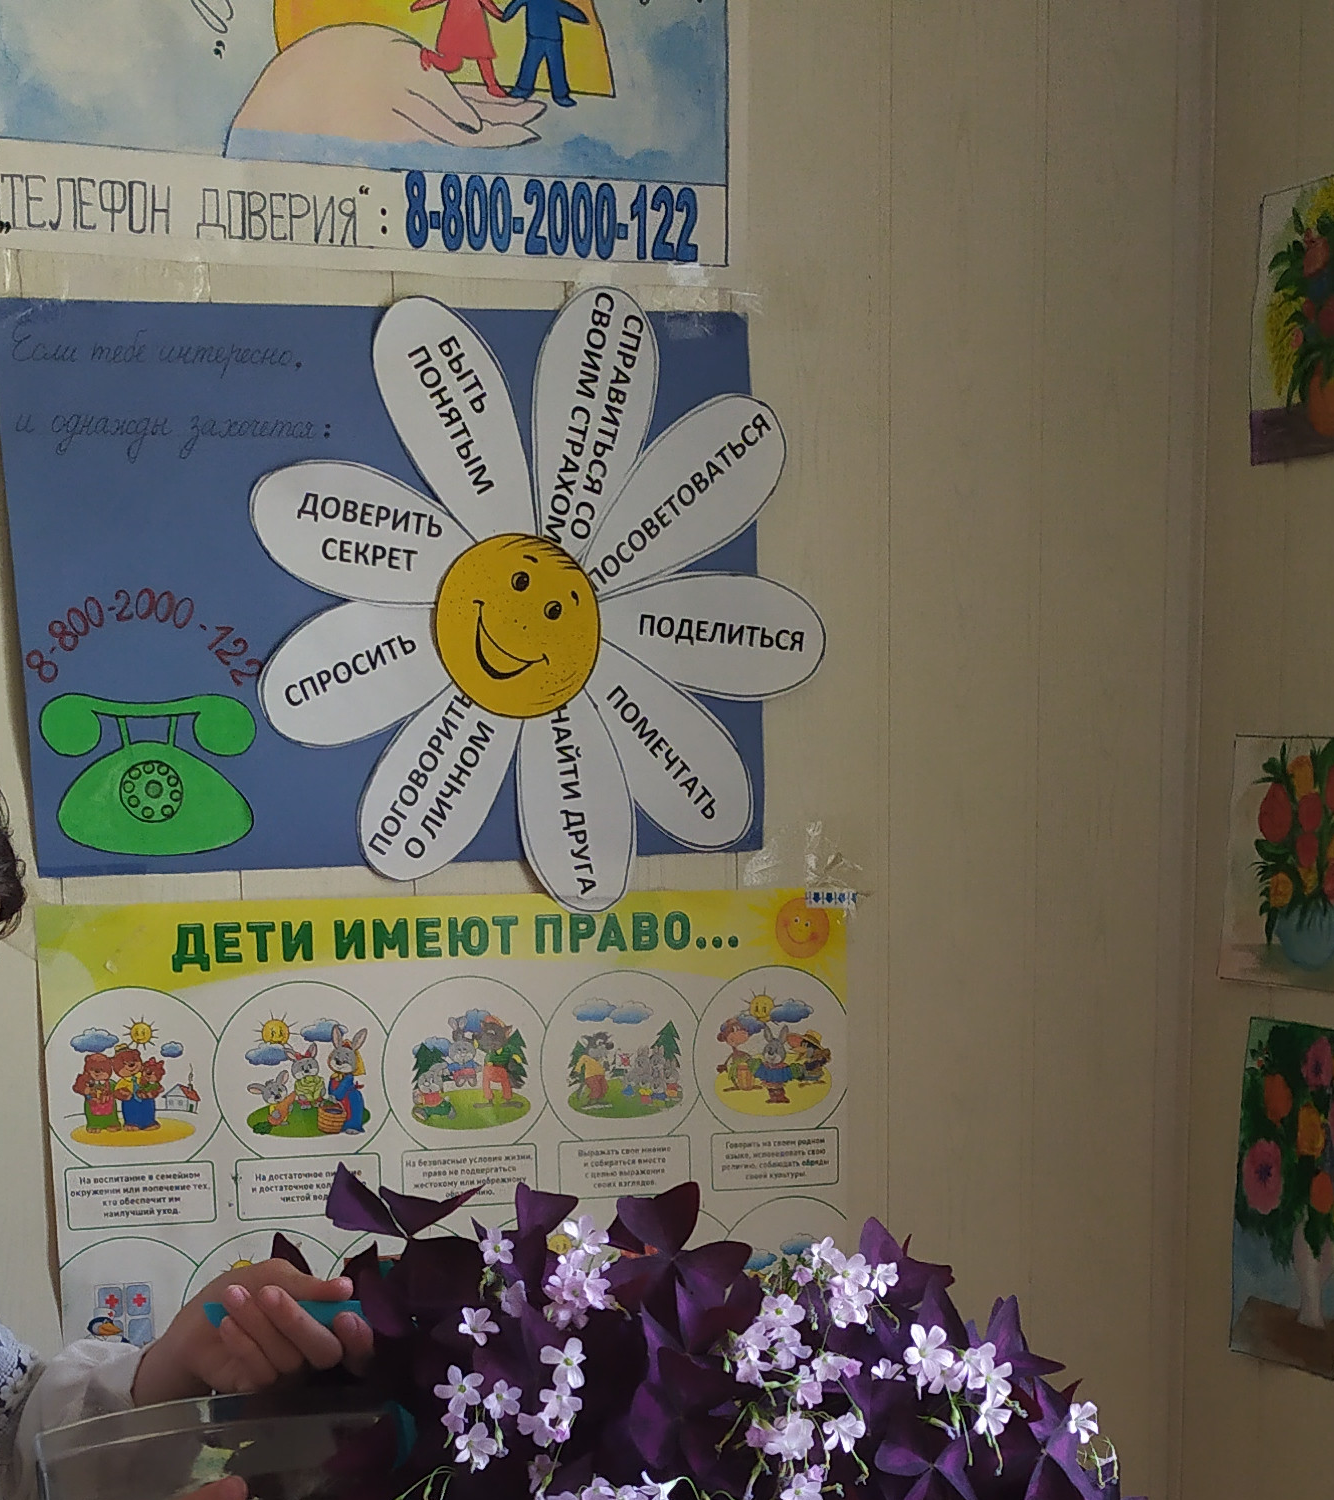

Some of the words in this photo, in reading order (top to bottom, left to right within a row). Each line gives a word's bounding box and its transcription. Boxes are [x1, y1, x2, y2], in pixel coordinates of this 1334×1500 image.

[404, 169, 700, 263] 8-800-2000-122
[11, 317, 78, 364] Если
[90, 328, 148, 364] тебе
[577, 290, 617, 401] СВОИМ
[437, 334, 490, 416] БЫТЬ
[406, 344, 496, 496] ПОНЯТЫМ
[582, 312, 645, 498] СПРАВИТЬСЯ
[15, 412, 37, 435] и
[51, 410, 173, 464] однажды
[543, 404, 592, 545] СТРАХОМ
[296, 490, 444, 540] ДОВЕРИТЬ
[570, 499, 597, 542] СО
[321, 536, 418, 574] СЕКРЕТ
[637, 613, 807, 654] ПОДЕЛИТЬСЯ
[283, 633, 418, 709] СПРОСИТЬ
[368, 692, 477, 858] ПОГОВОРИТЬ
[549, 704, 585, 802] НАЙТИ
[606, 684, 718, 822] ПОМЕЧТАТЬ
[404, 835, 427, 860] О
[422, 719, 496, 844] ЛИЧНОМ
[563, 809, 598, 898] ДРУГА
[170, 918, 315, 973] ДЕТИ
[333, 914, 519, 963] ИМЕЮТ
[535, 909, 740, 954] ПРАВО...
[70, 1186, 121, 1198] окружении
[123, 1186, 141, 1194] или
[142, 1184, 191, 1194] попечение
[79, 1176, 91, 1185] На
[93, 1174, 146, 1185] воспитание
[155, 1171, 201, 1181] семейном
[255, 1173, 267, 1182] На
[268, 1171, 323, 1182] достаточное
[259, 1184, 314, 1194] достаточное
[460, 1165, 517, 1176] подвергаться
[102, 1199, 118, 1207] кто
[119, 1197, 167, 1206] обеспечит
[168, 1195, 181, 1203] им
[103, 1207, 155, 1219] наилучший
[156, 1207, 181, 1216] уход.
[280, 1193, 311, 1203] чистой
